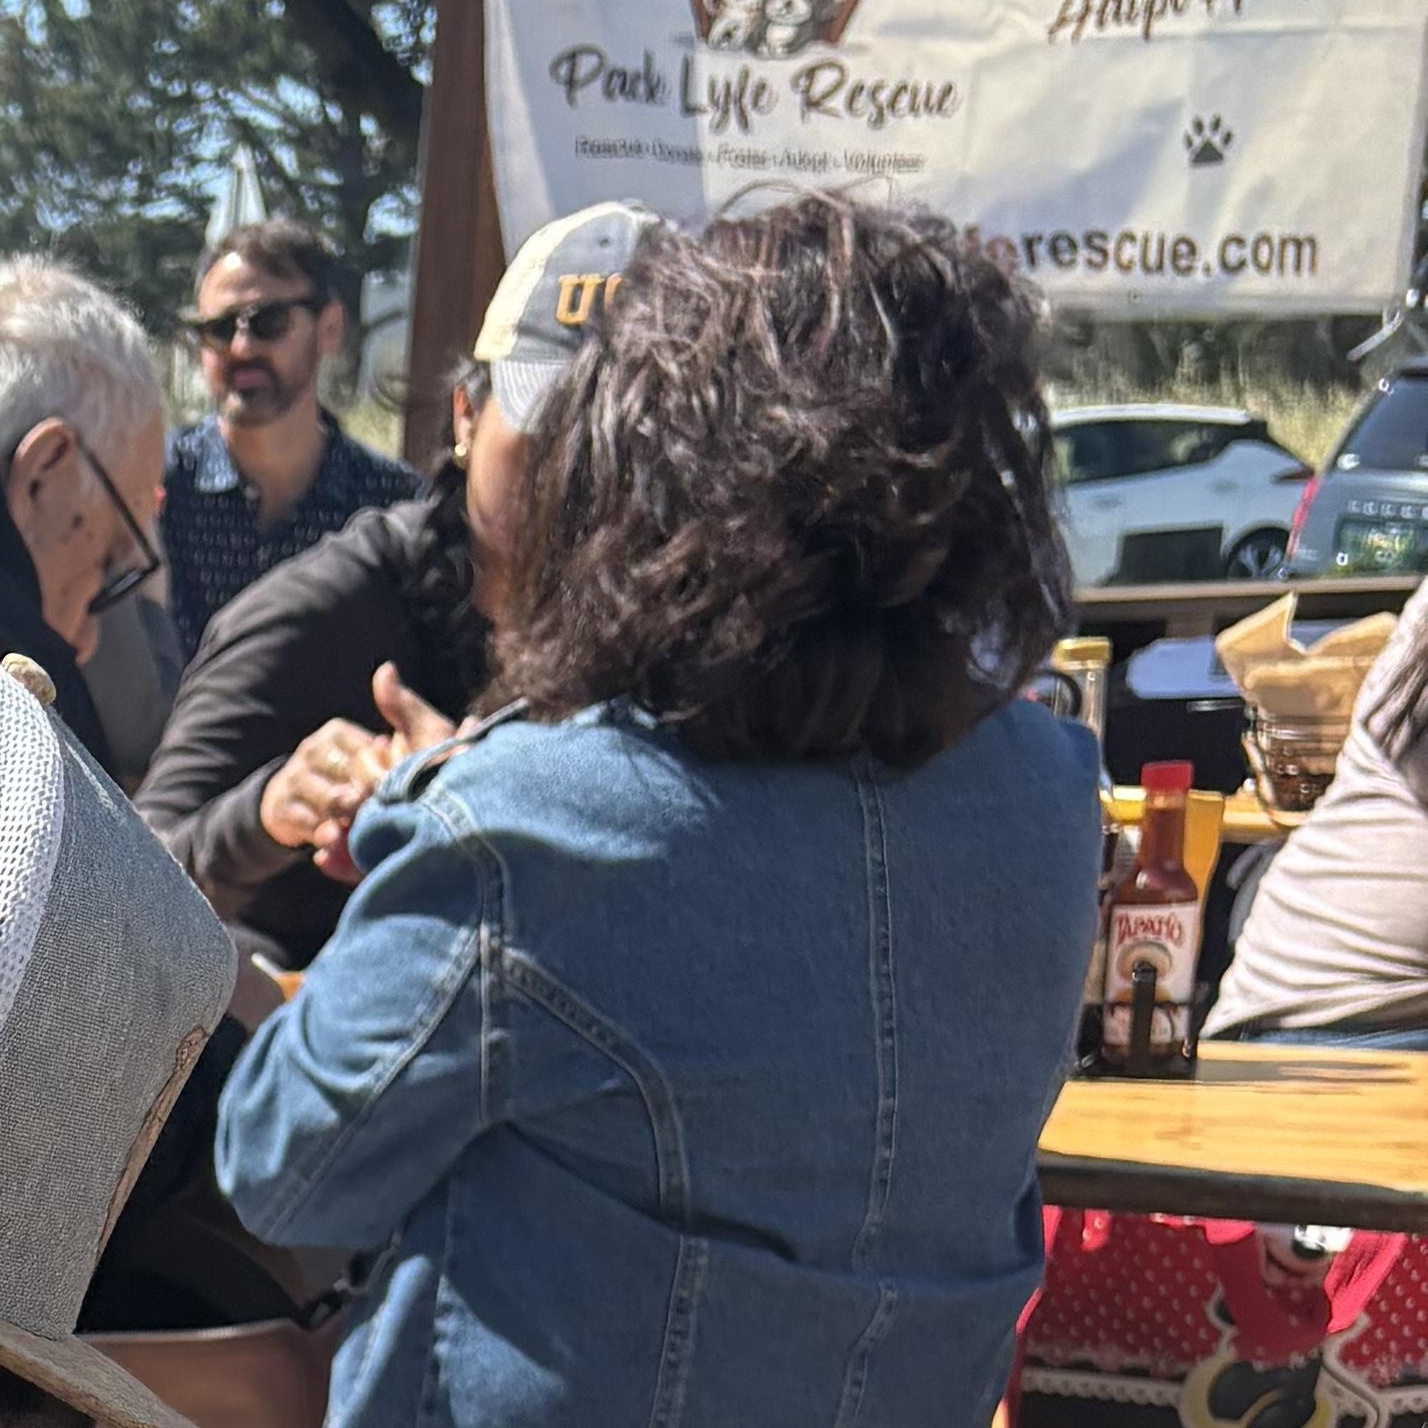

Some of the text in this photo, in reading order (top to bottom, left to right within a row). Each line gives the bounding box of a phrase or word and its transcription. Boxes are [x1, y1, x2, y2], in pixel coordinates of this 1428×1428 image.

[548, 43, 961, 134] Pack Lyfe Rescue
